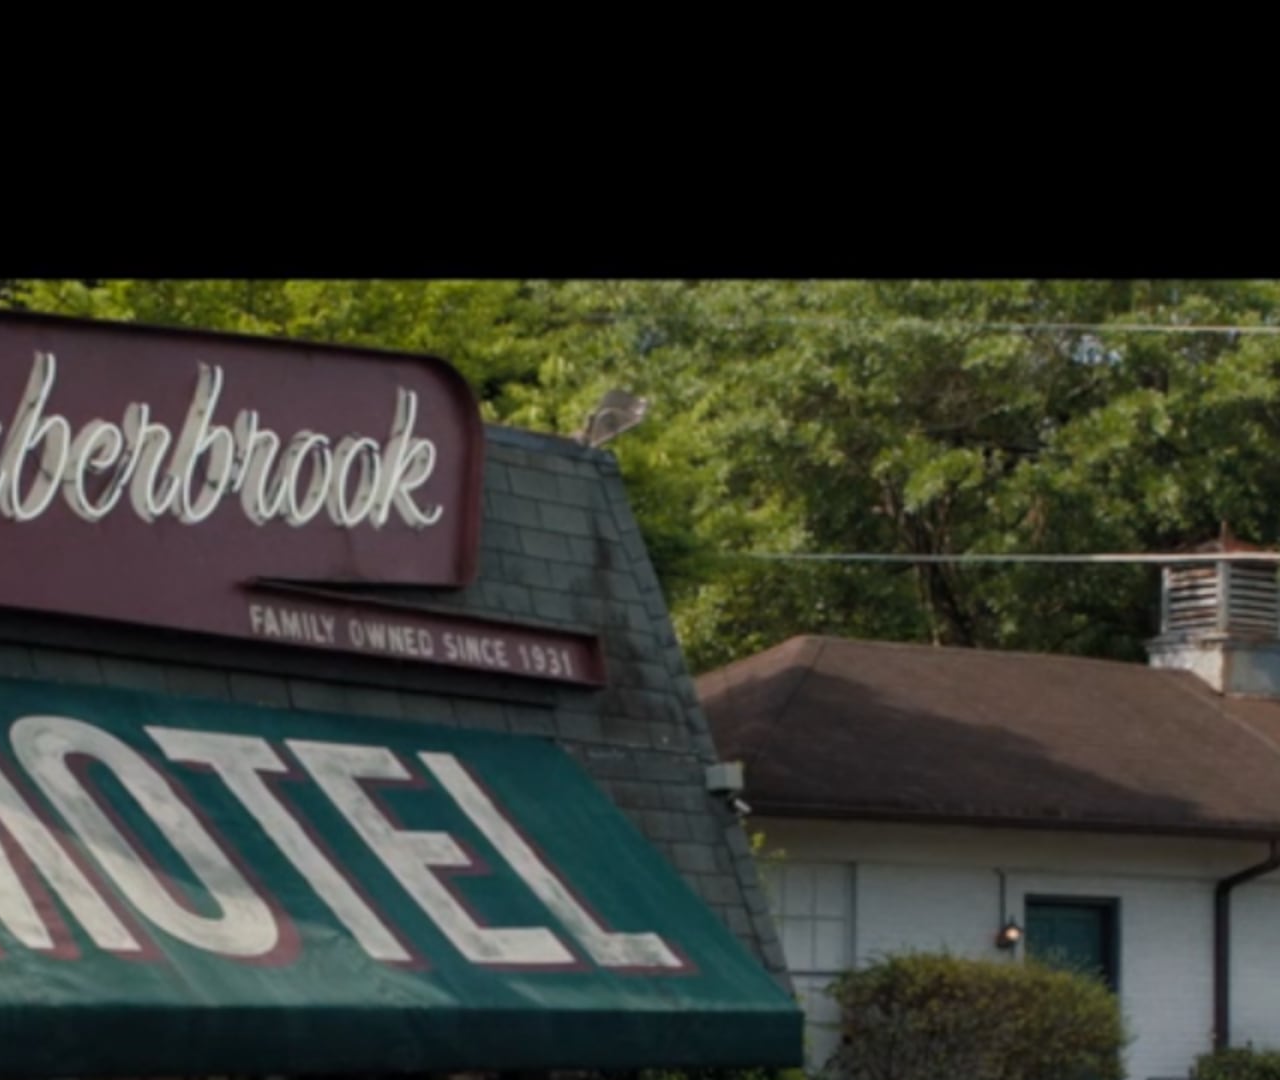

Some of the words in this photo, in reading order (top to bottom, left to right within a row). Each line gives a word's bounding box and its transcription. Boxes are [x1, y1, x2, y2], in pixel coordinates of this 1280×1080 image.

[248, 604, 336, 643] FAMILY
[348, 618, 434, 658] OWNED
[442, 632, 510, 669] SINCE
[519, 645, 575, 677] 1931
